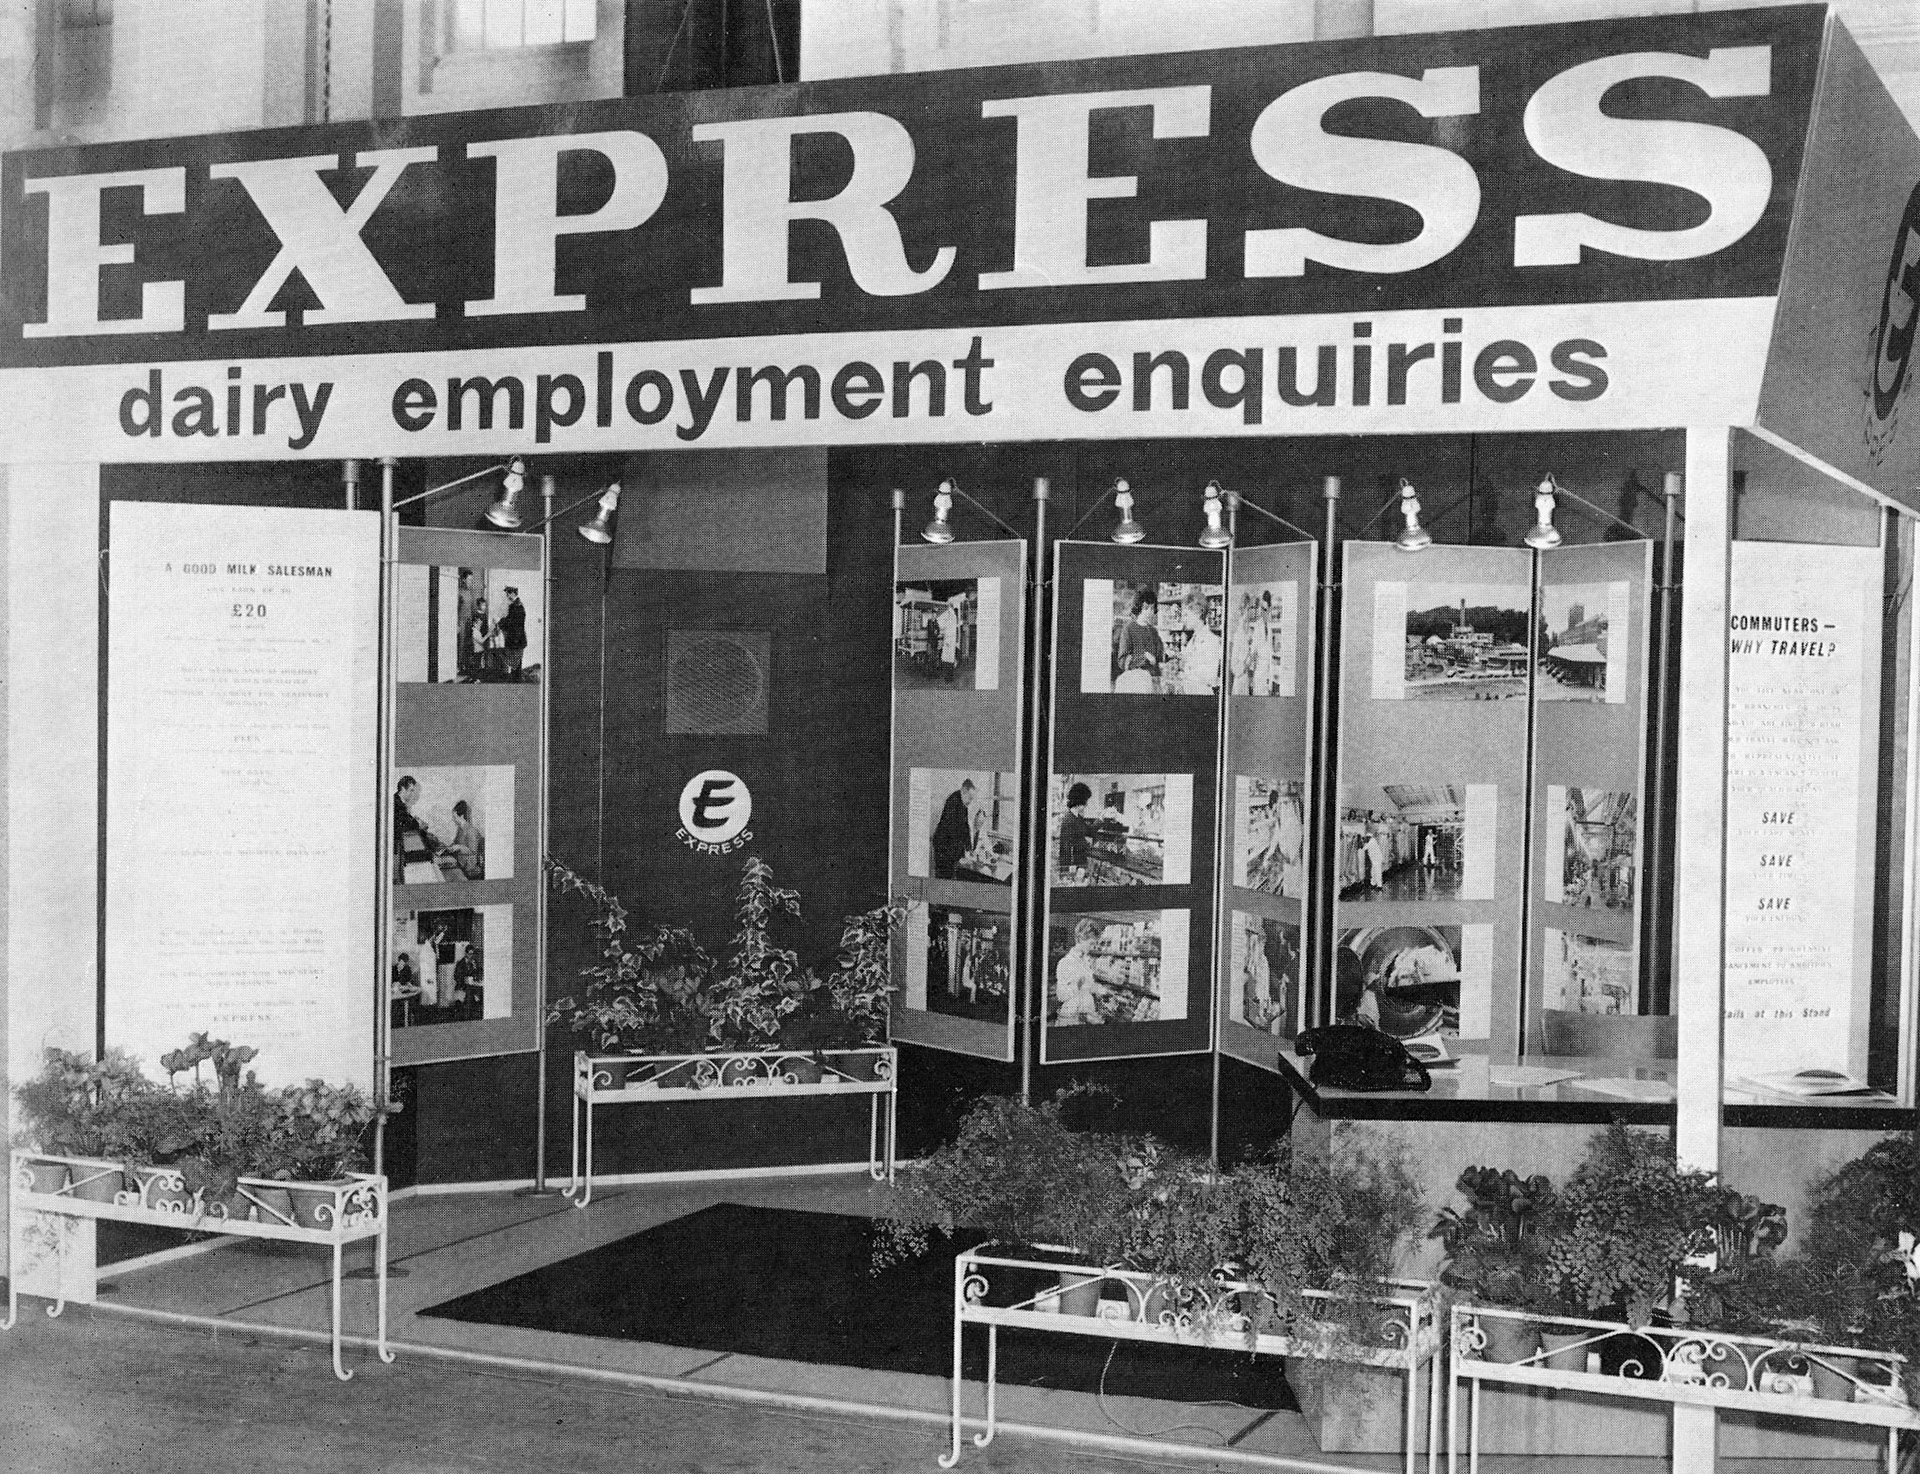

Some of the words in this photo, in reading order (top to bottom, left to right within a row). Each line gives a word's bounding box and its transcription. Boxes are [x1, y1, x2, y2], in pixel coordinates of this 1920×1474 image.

[21, 45, 1773, 340] EXPRESS
[119, 366, 334, 451] dairy
[391, 335, 995, 445] employment
[1063, 317, 1609, 425] enquiries
[164, 562, 173, 573] A
[182, 563, 218, 575] GOOD
[226, 563, 258, 576] MILK
[266, 564, 334, 578] SALESMAN
[231, 602, 268, 619] £20
[1730, 614, 1818, 634] COMMUTERS
[1730, 638, 1763, 655] WHY
[1770, 639, 1836, 657] TRAVEL?
[1762, 811, 1796, 826] SAVE
[675, 827, 753, 855] EXPRESS
[1760, 854, 1794, 869] SAVE
[1758, 897, 1792, 912] SAVE
[1726, 1009, 1745, 1020] ails
[1802, 1007, 1832, 1019] Stand
